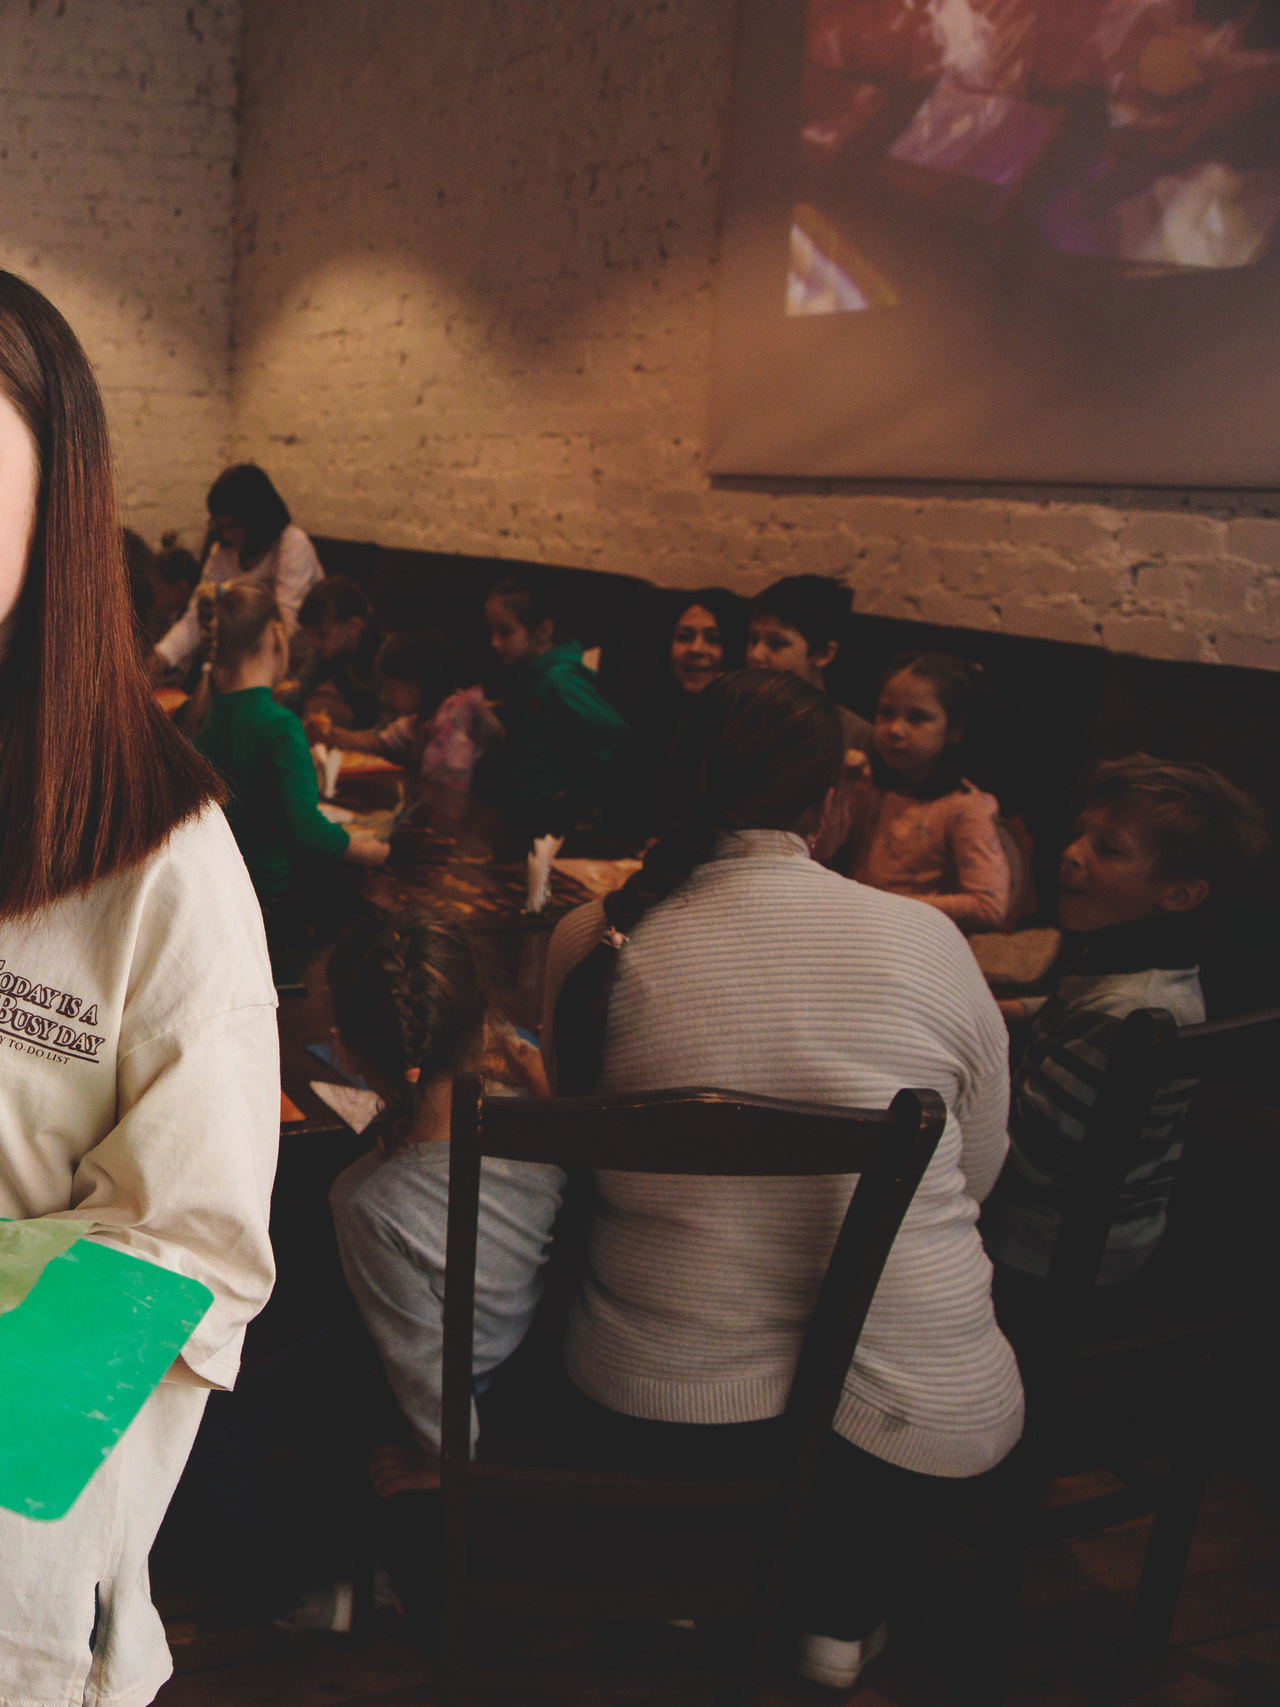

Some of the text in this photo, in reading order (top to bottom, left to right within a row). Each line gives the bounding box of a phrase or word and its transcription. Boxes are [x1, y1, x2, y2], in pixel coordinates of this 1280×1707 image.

[56, 994, 82, 1018] IS
[79, 1004, 98, 1025] A
[9, 1039, 44, 1057] TO-DO
[46, 1052, 70, 1065] LIST
[53, 1025, 105, 1055] DAY
